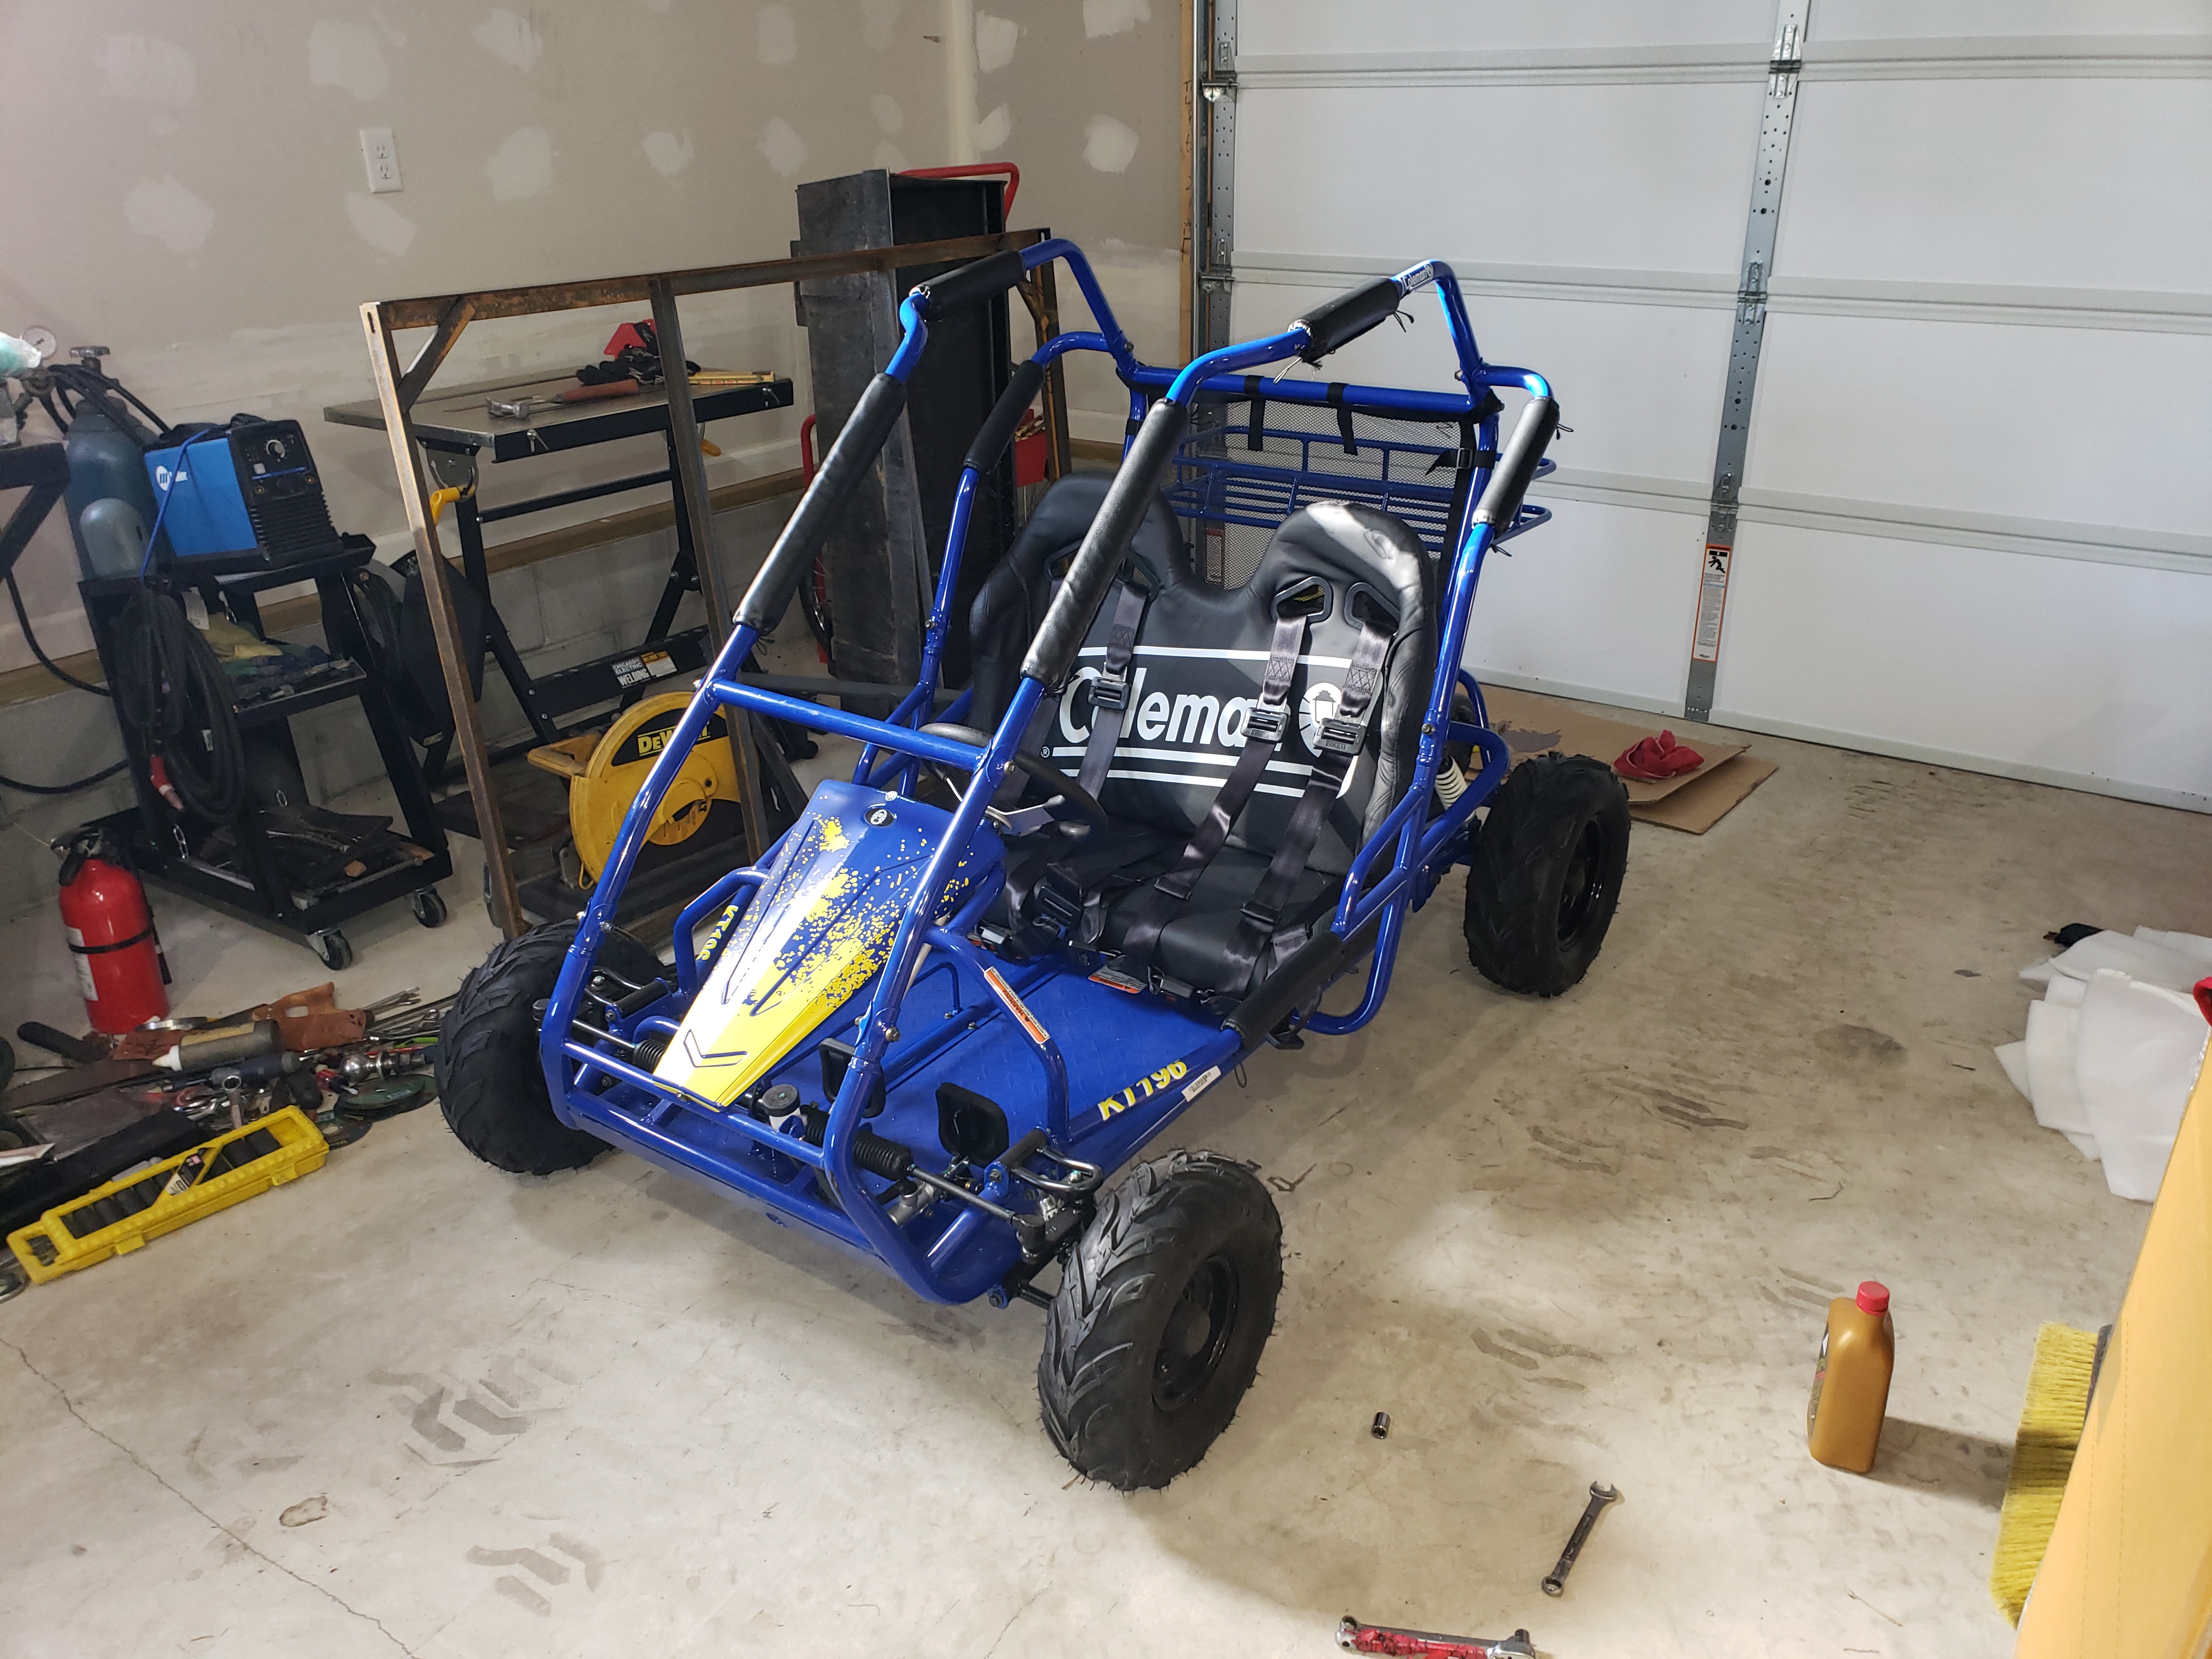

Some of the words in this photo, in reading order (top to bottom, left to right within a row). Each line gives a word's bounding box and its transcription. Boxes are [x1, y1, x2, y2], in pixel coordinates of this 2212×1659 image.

[1402, 269, 1427, 290] Coleman
[613, 659, 636, 670] CHICAGO
[616, 662, 643, 674] ELECTRIC
[617, 668, 650, 686] WELDING
[1059, 665, 1291, 752] Clema
[637, 720, 710, 754] DEWT
